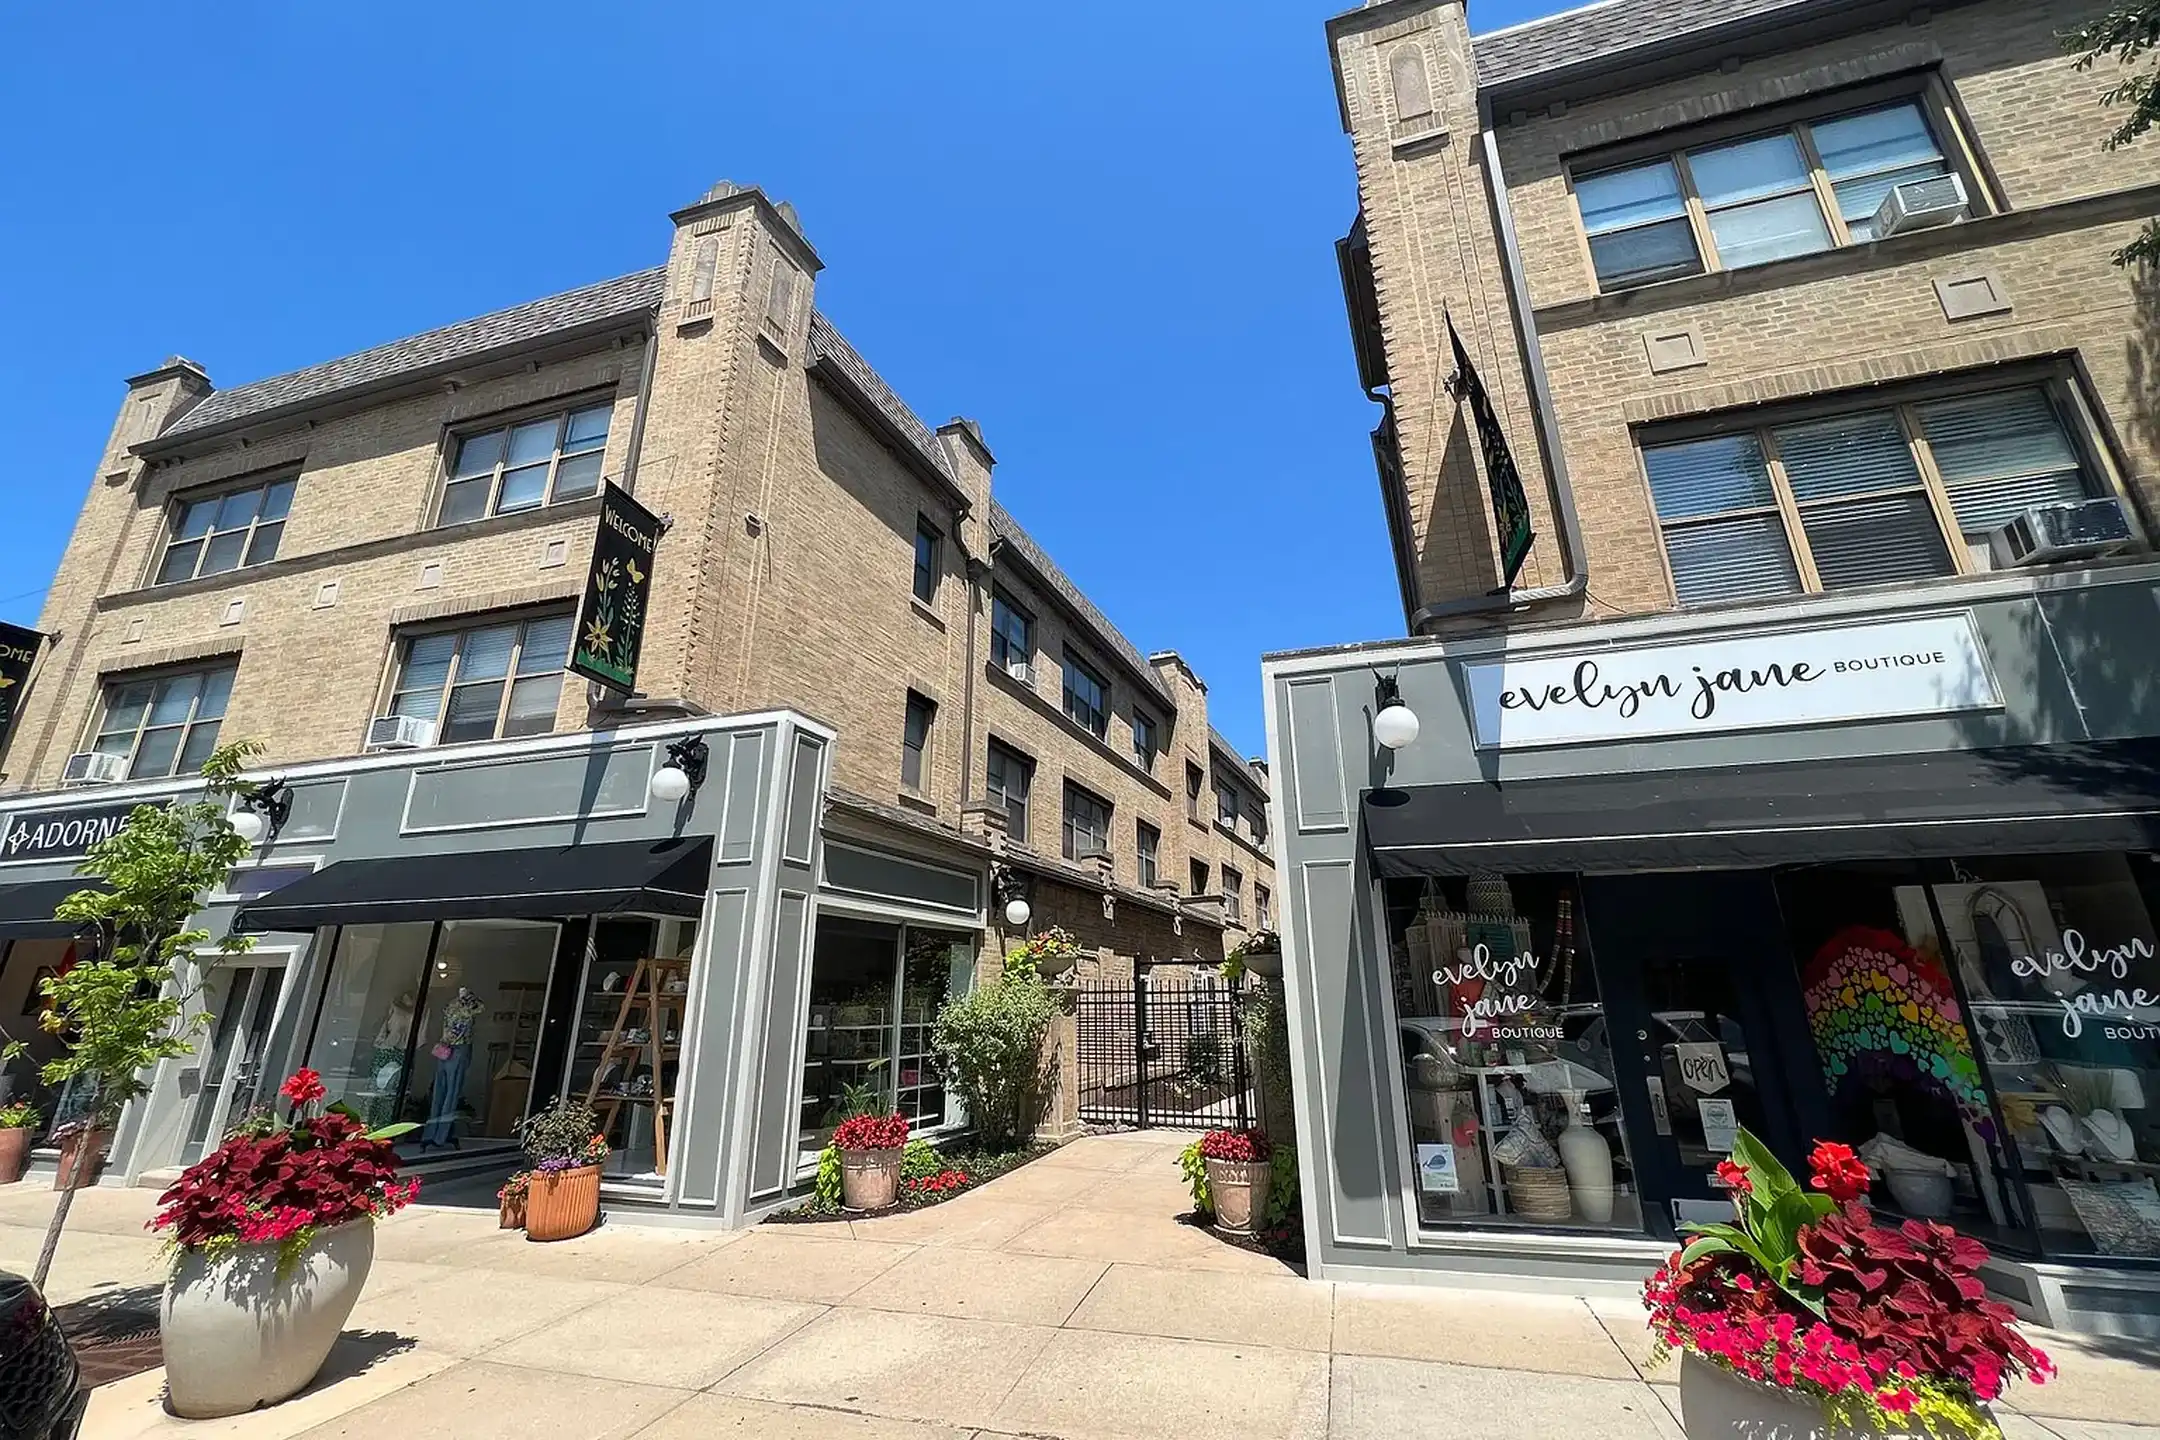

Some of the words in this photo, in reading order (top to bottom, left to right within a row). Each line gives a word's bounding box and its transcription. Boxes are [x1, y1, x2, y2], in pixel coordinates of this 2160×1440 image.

[605, 504, 653, 553] WELCOME
[1499, 660, 1682, 718] evelyn
[1691, 662, 1826, 719] jane
[1834, 651, 1946, 673] BOUTIQUE
[1432, 943, 1539, 986] evelyn
[2011, 929, 2154, 979] evelyn
[1460, 994, 1537, 1037] jane
[1492, 1027, 1565, 1039] BOUTIQUE
[2054, 988, 2160, 1038] jane
